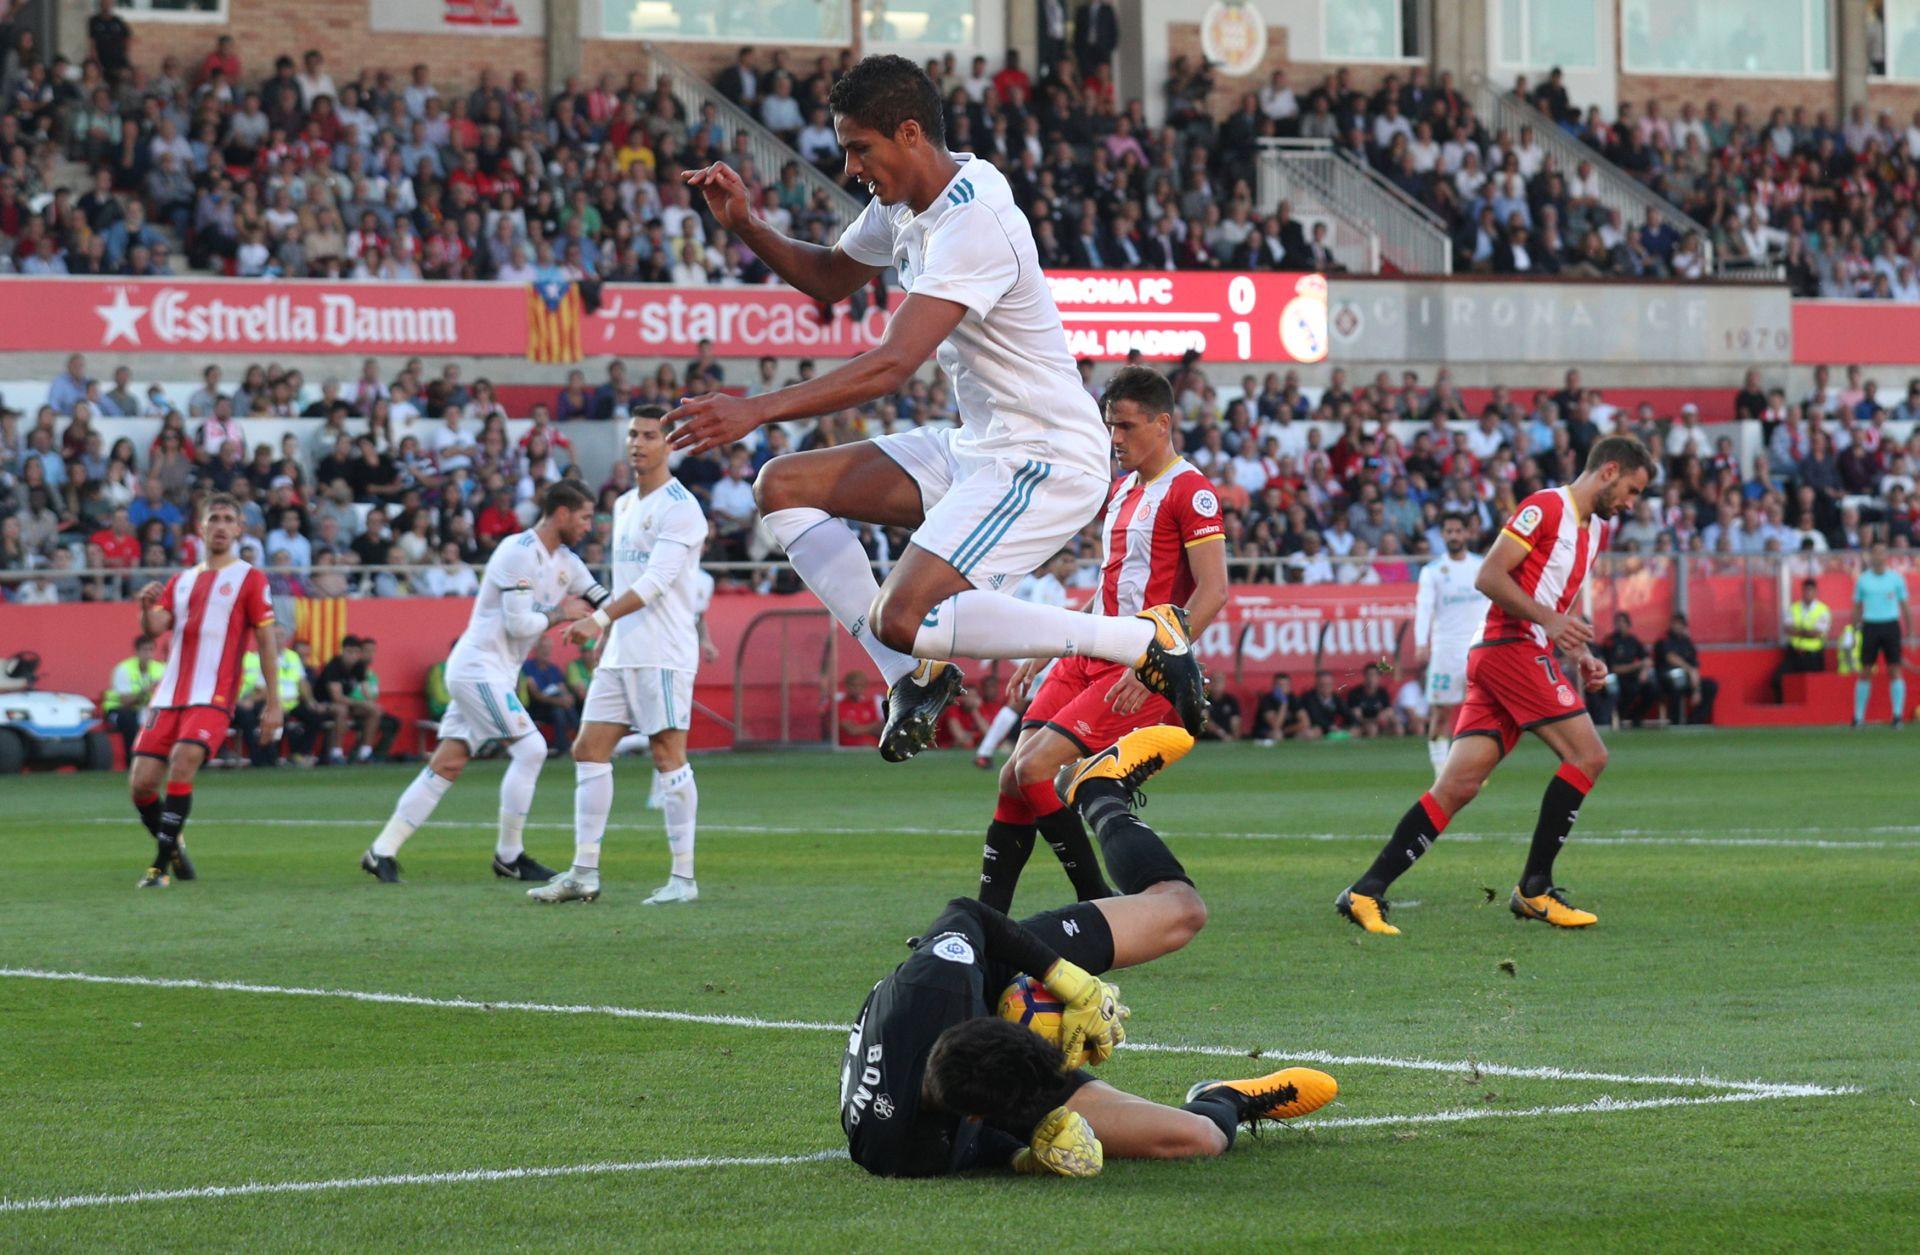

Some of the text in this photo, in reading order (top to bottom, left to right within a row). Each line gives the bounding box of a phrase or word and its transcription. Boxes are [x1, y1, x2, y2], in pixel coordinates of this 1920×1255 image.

[1139, 277, 1174, 305] FC
[1228, 275, 1257, 315] 0
[150, 287, 458, 346] Estrella Damm
[1232, 321, 1252, 361] 1
[1193, 524, 1221, 536] umbro
[1432, 673, 1451, 690] 22
[1535, 655, 1559, 685] 7
